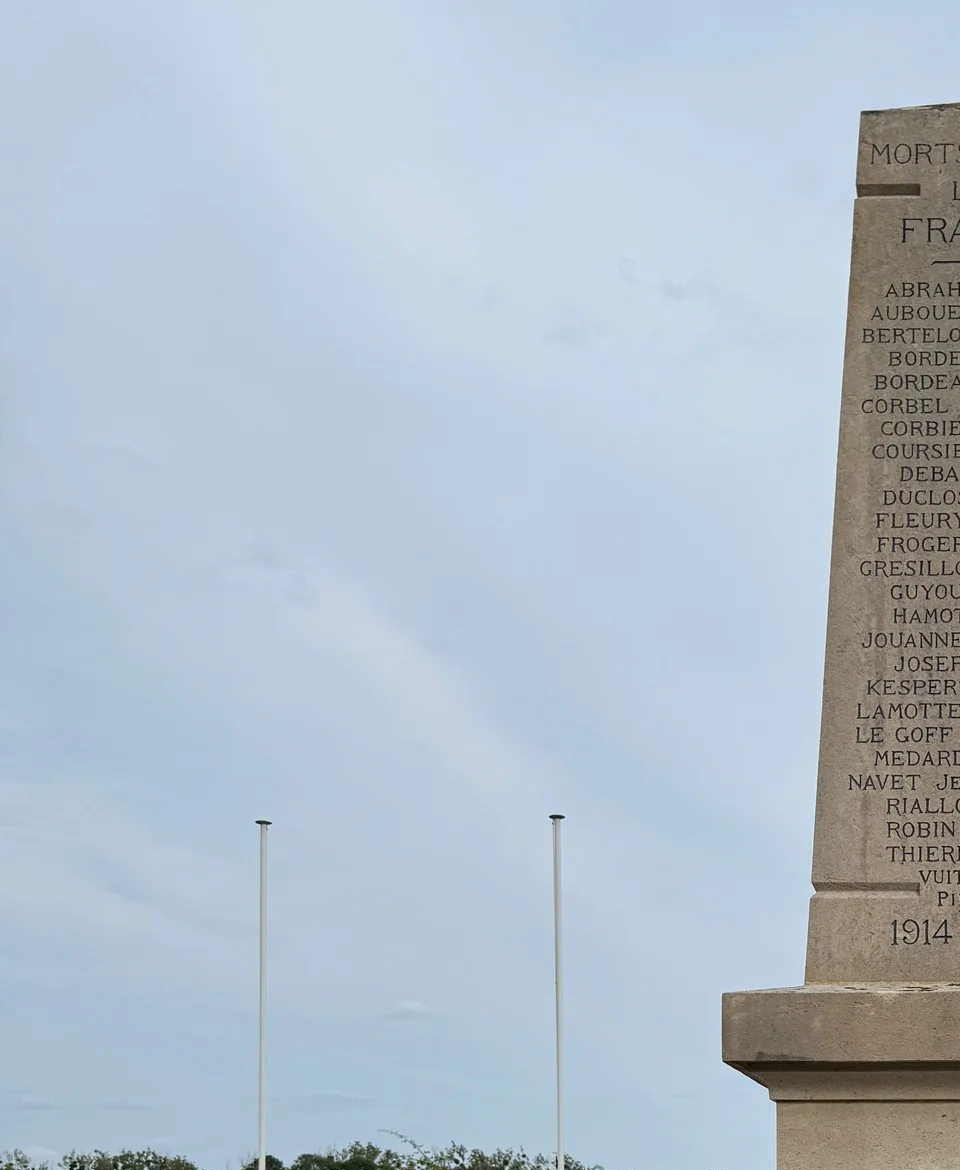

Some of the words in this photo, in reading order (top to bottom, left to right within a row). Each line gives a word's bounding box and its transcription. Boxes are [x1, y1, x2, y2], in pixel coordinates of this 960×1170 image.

[861, 399, 949, 414] CORBEL
[857, 703, 960, 719] LAMOTTE
[855, 727, 884, 743] LE
[896, 727, 953, 743] GOFF
[848, 775, 921, 790] NAVET
[886, 821, 955, 838] ROBIN
[890, 919, 953, 946] 1914
